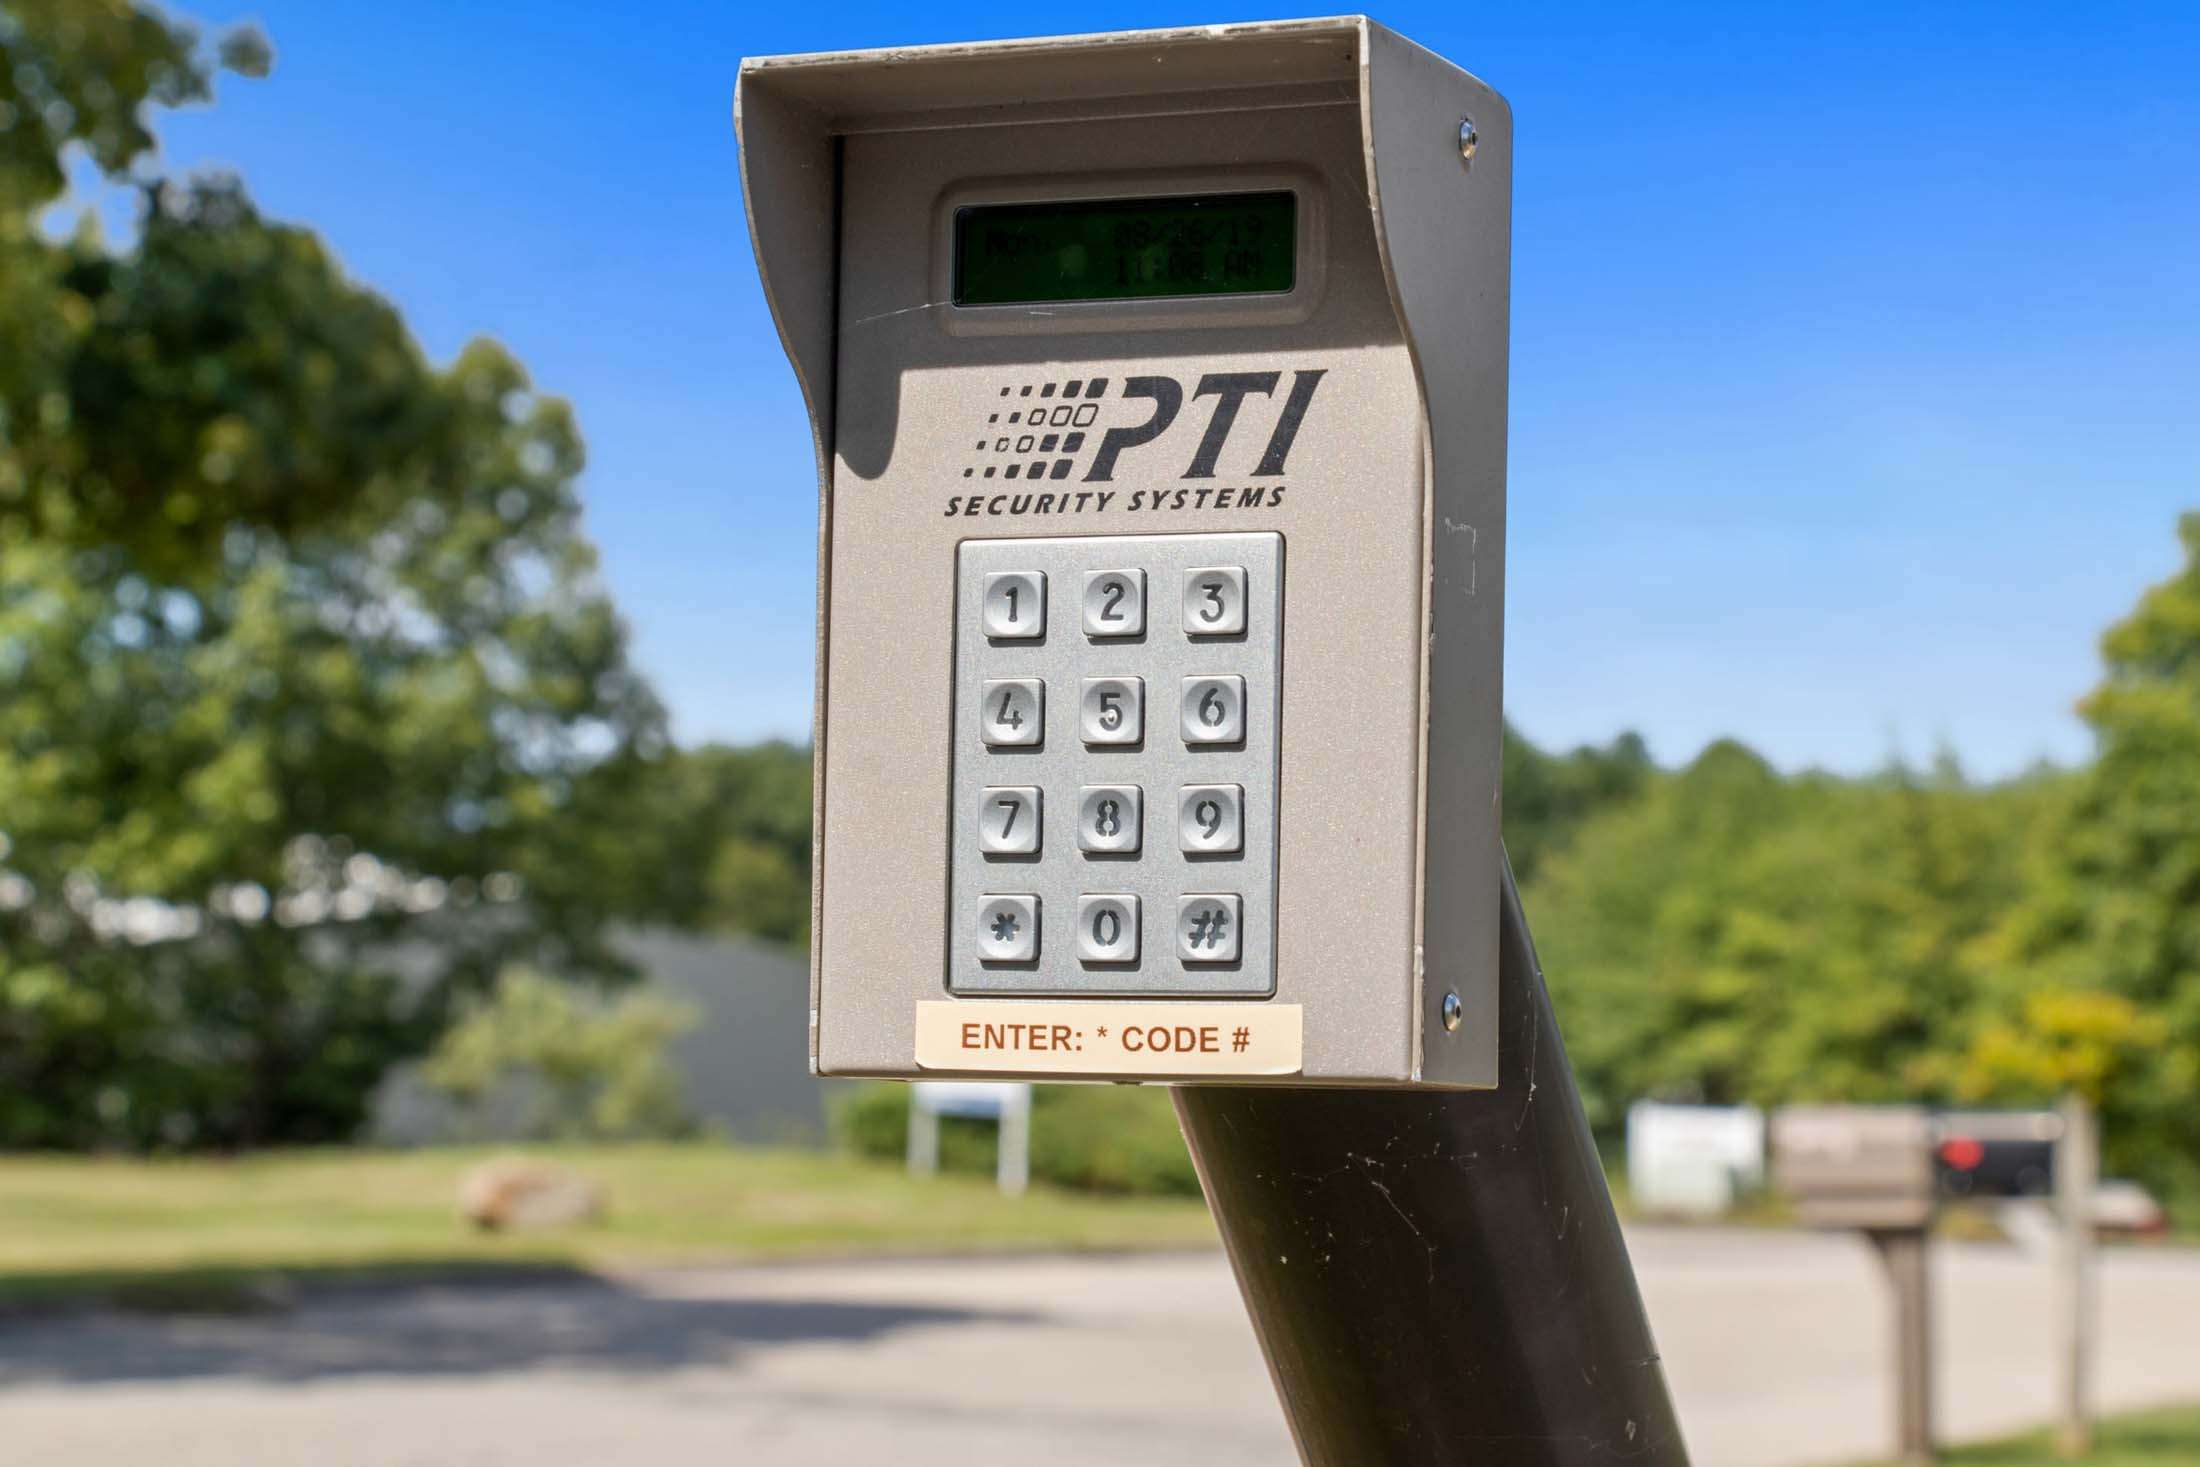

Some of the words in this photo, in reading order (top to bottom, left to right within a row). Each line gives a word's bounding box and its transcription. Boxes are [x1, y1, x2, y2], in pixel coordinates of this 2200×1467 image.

[1081, 368, 1329, 483] PTI
[944, 490, 1116, 518] SECURITY
[1127, 485, 1286, 513] SYSTEMS
[1004, 585, 1018, 622] 1
[1100, 582, 1125, 621] 2
[1199, 583, 1225, 623] 3
[995, 692, 1023, 731] 4
[1098, 692, 1124, 732] 5
[1199, 687, 1226, 728] 6
[997, 800, 1021, 840] 7
[1095, 799, 1121, 837] 8
[1195, 800, 1222, 840] 9
[1092, 909, 1121, 946] 0
[1188, 909, 1229, 949] #
[960, 1022, 1083, 1052] ENTER:
[1121, 1025, 1220, 1053] CODE
[1232, 1026, 1251, 1053] #
